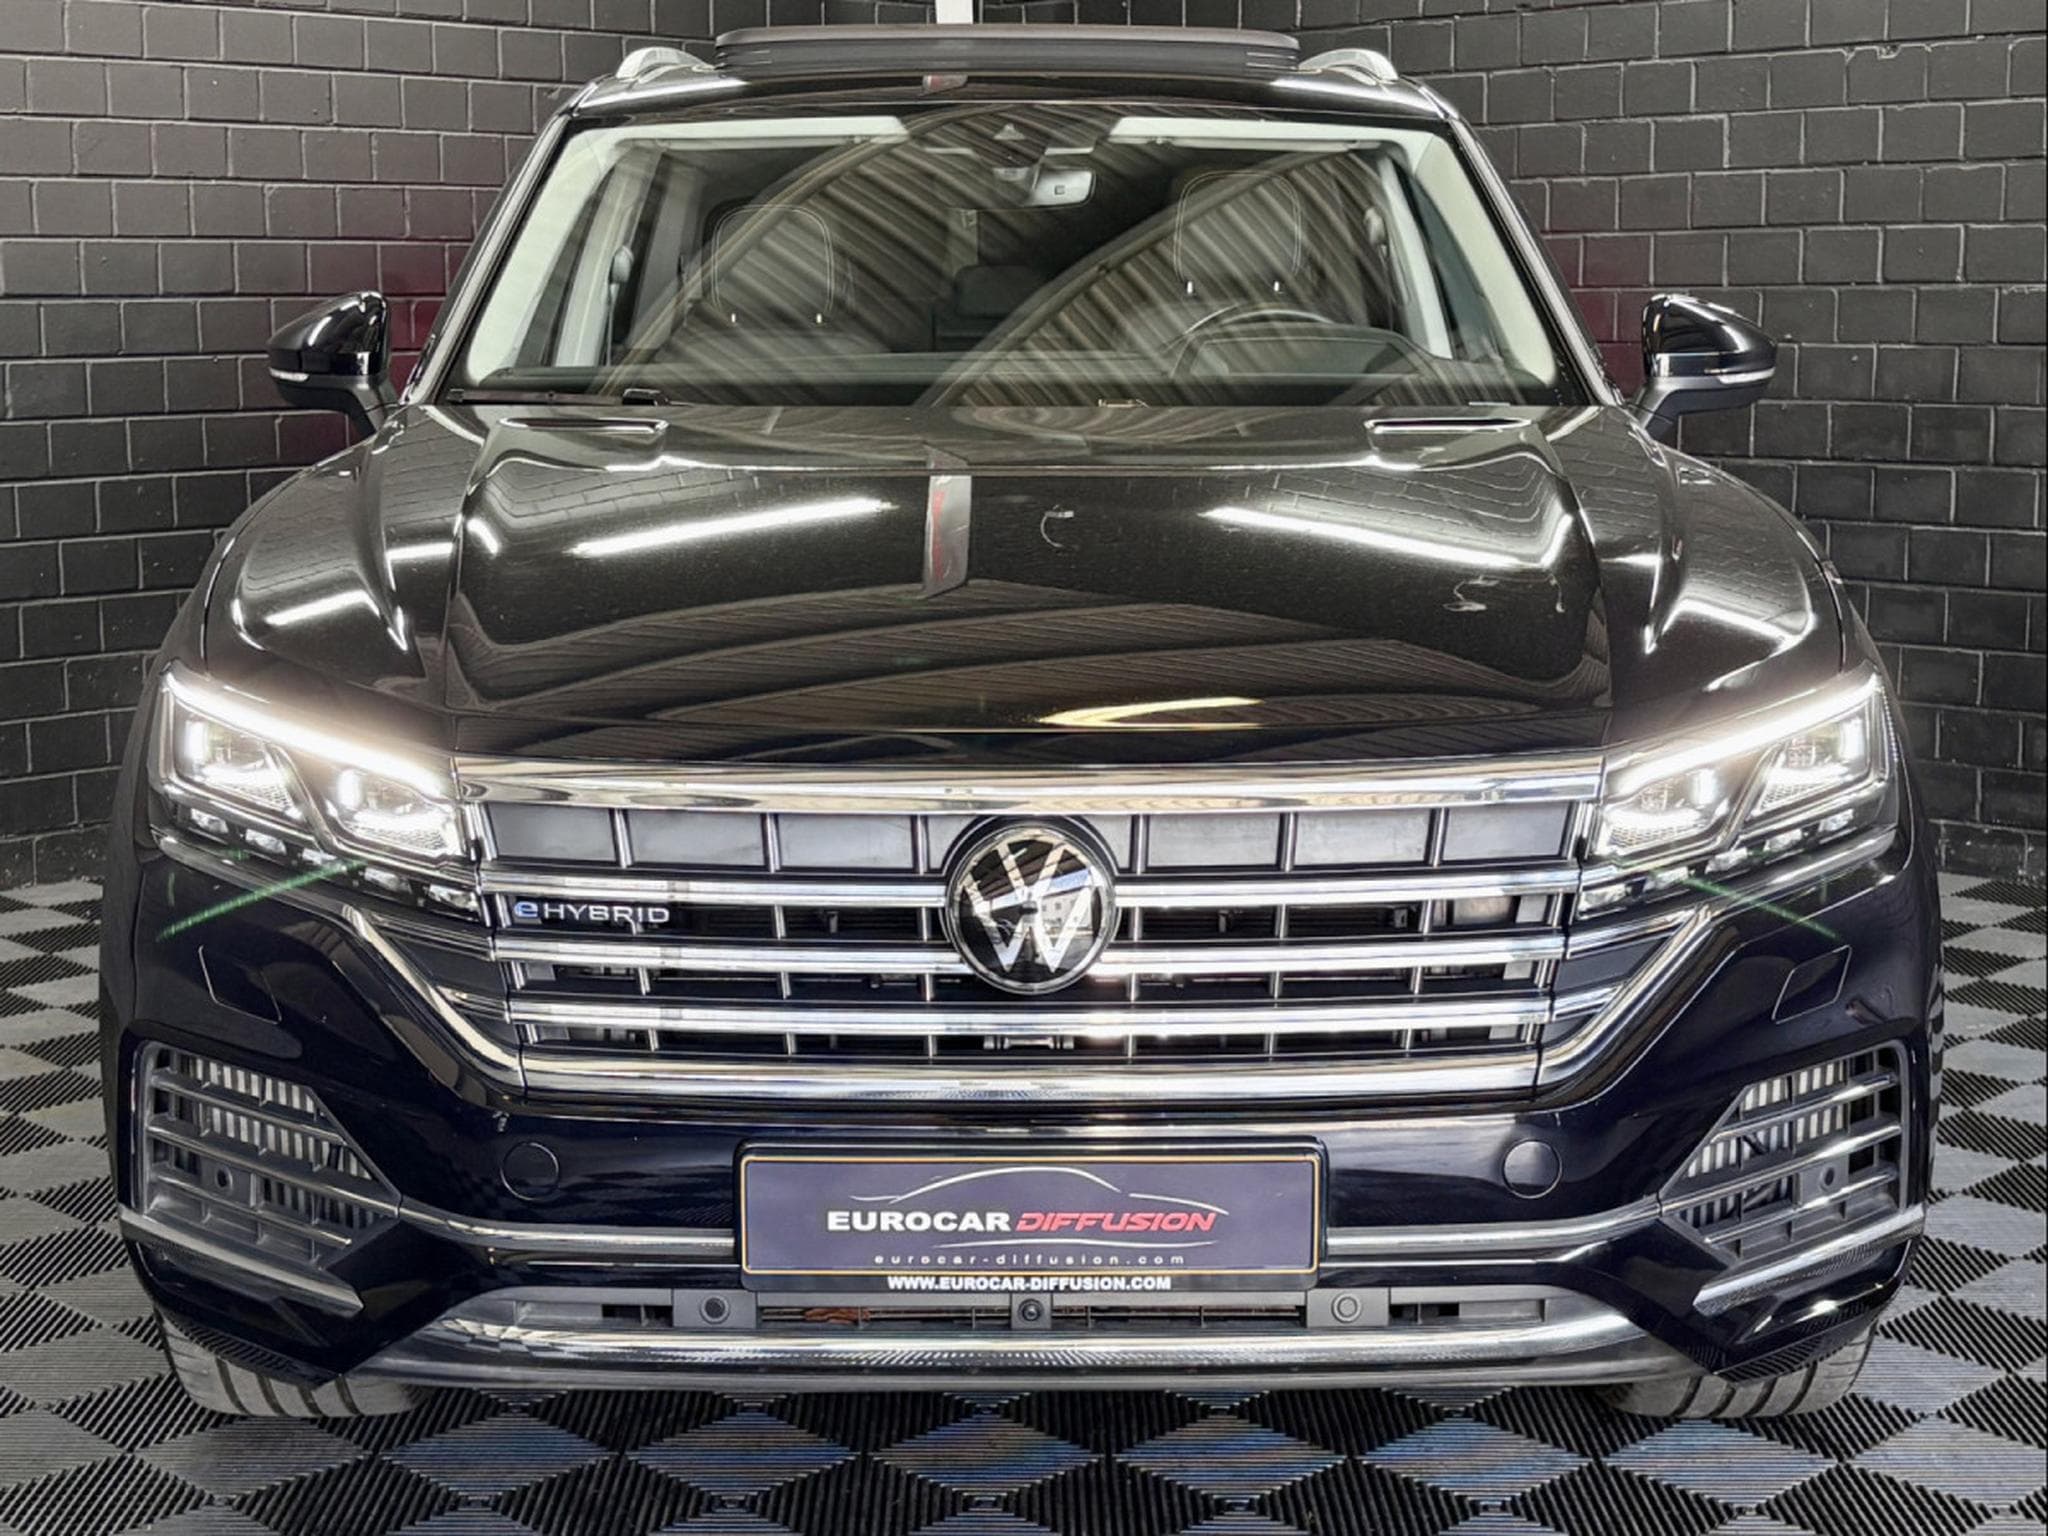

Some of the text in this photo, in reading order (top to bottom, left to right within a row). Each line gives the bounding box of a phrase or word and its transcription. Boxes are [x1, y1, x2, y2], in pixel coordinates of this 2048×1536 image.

[827, 1210, 1217, 1232] EUROCAR DIFFUSION
[874, 1254, 1185, 1265] eurocar-diffusion.com
[887, 1276, 1171, 1290] WWW.EUROCAR-DIFFUSION.COM
